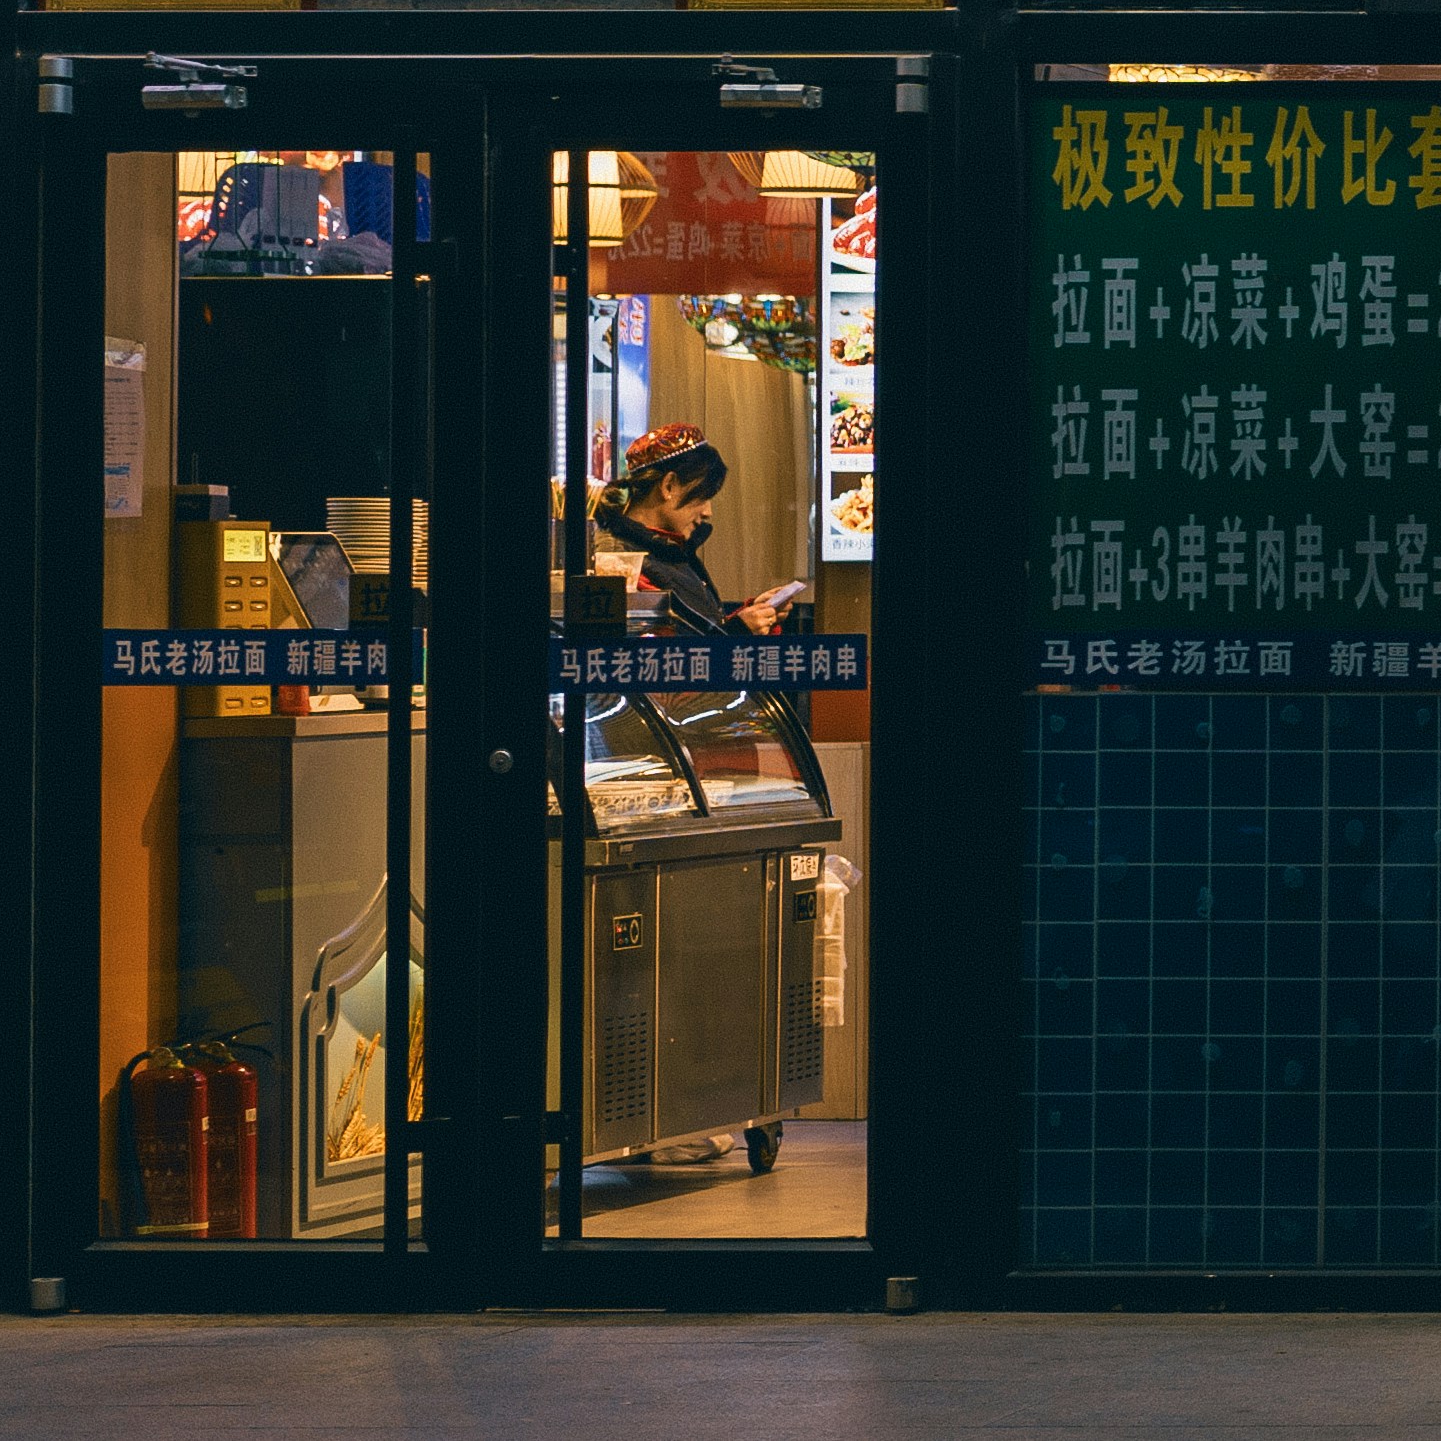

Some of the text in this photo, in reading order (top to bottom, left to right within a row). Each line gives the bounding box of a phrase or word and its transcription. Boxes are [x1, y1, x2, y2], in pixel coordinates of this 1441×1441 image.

[114, 639, 388, 676] 马氏老汤拉面 新疆羊肉
[560, 647, 857, 684] 马氏老汤拉面 新疆羊肉串
[1040, 639, 1294, 676] 马氏老汤拉面
